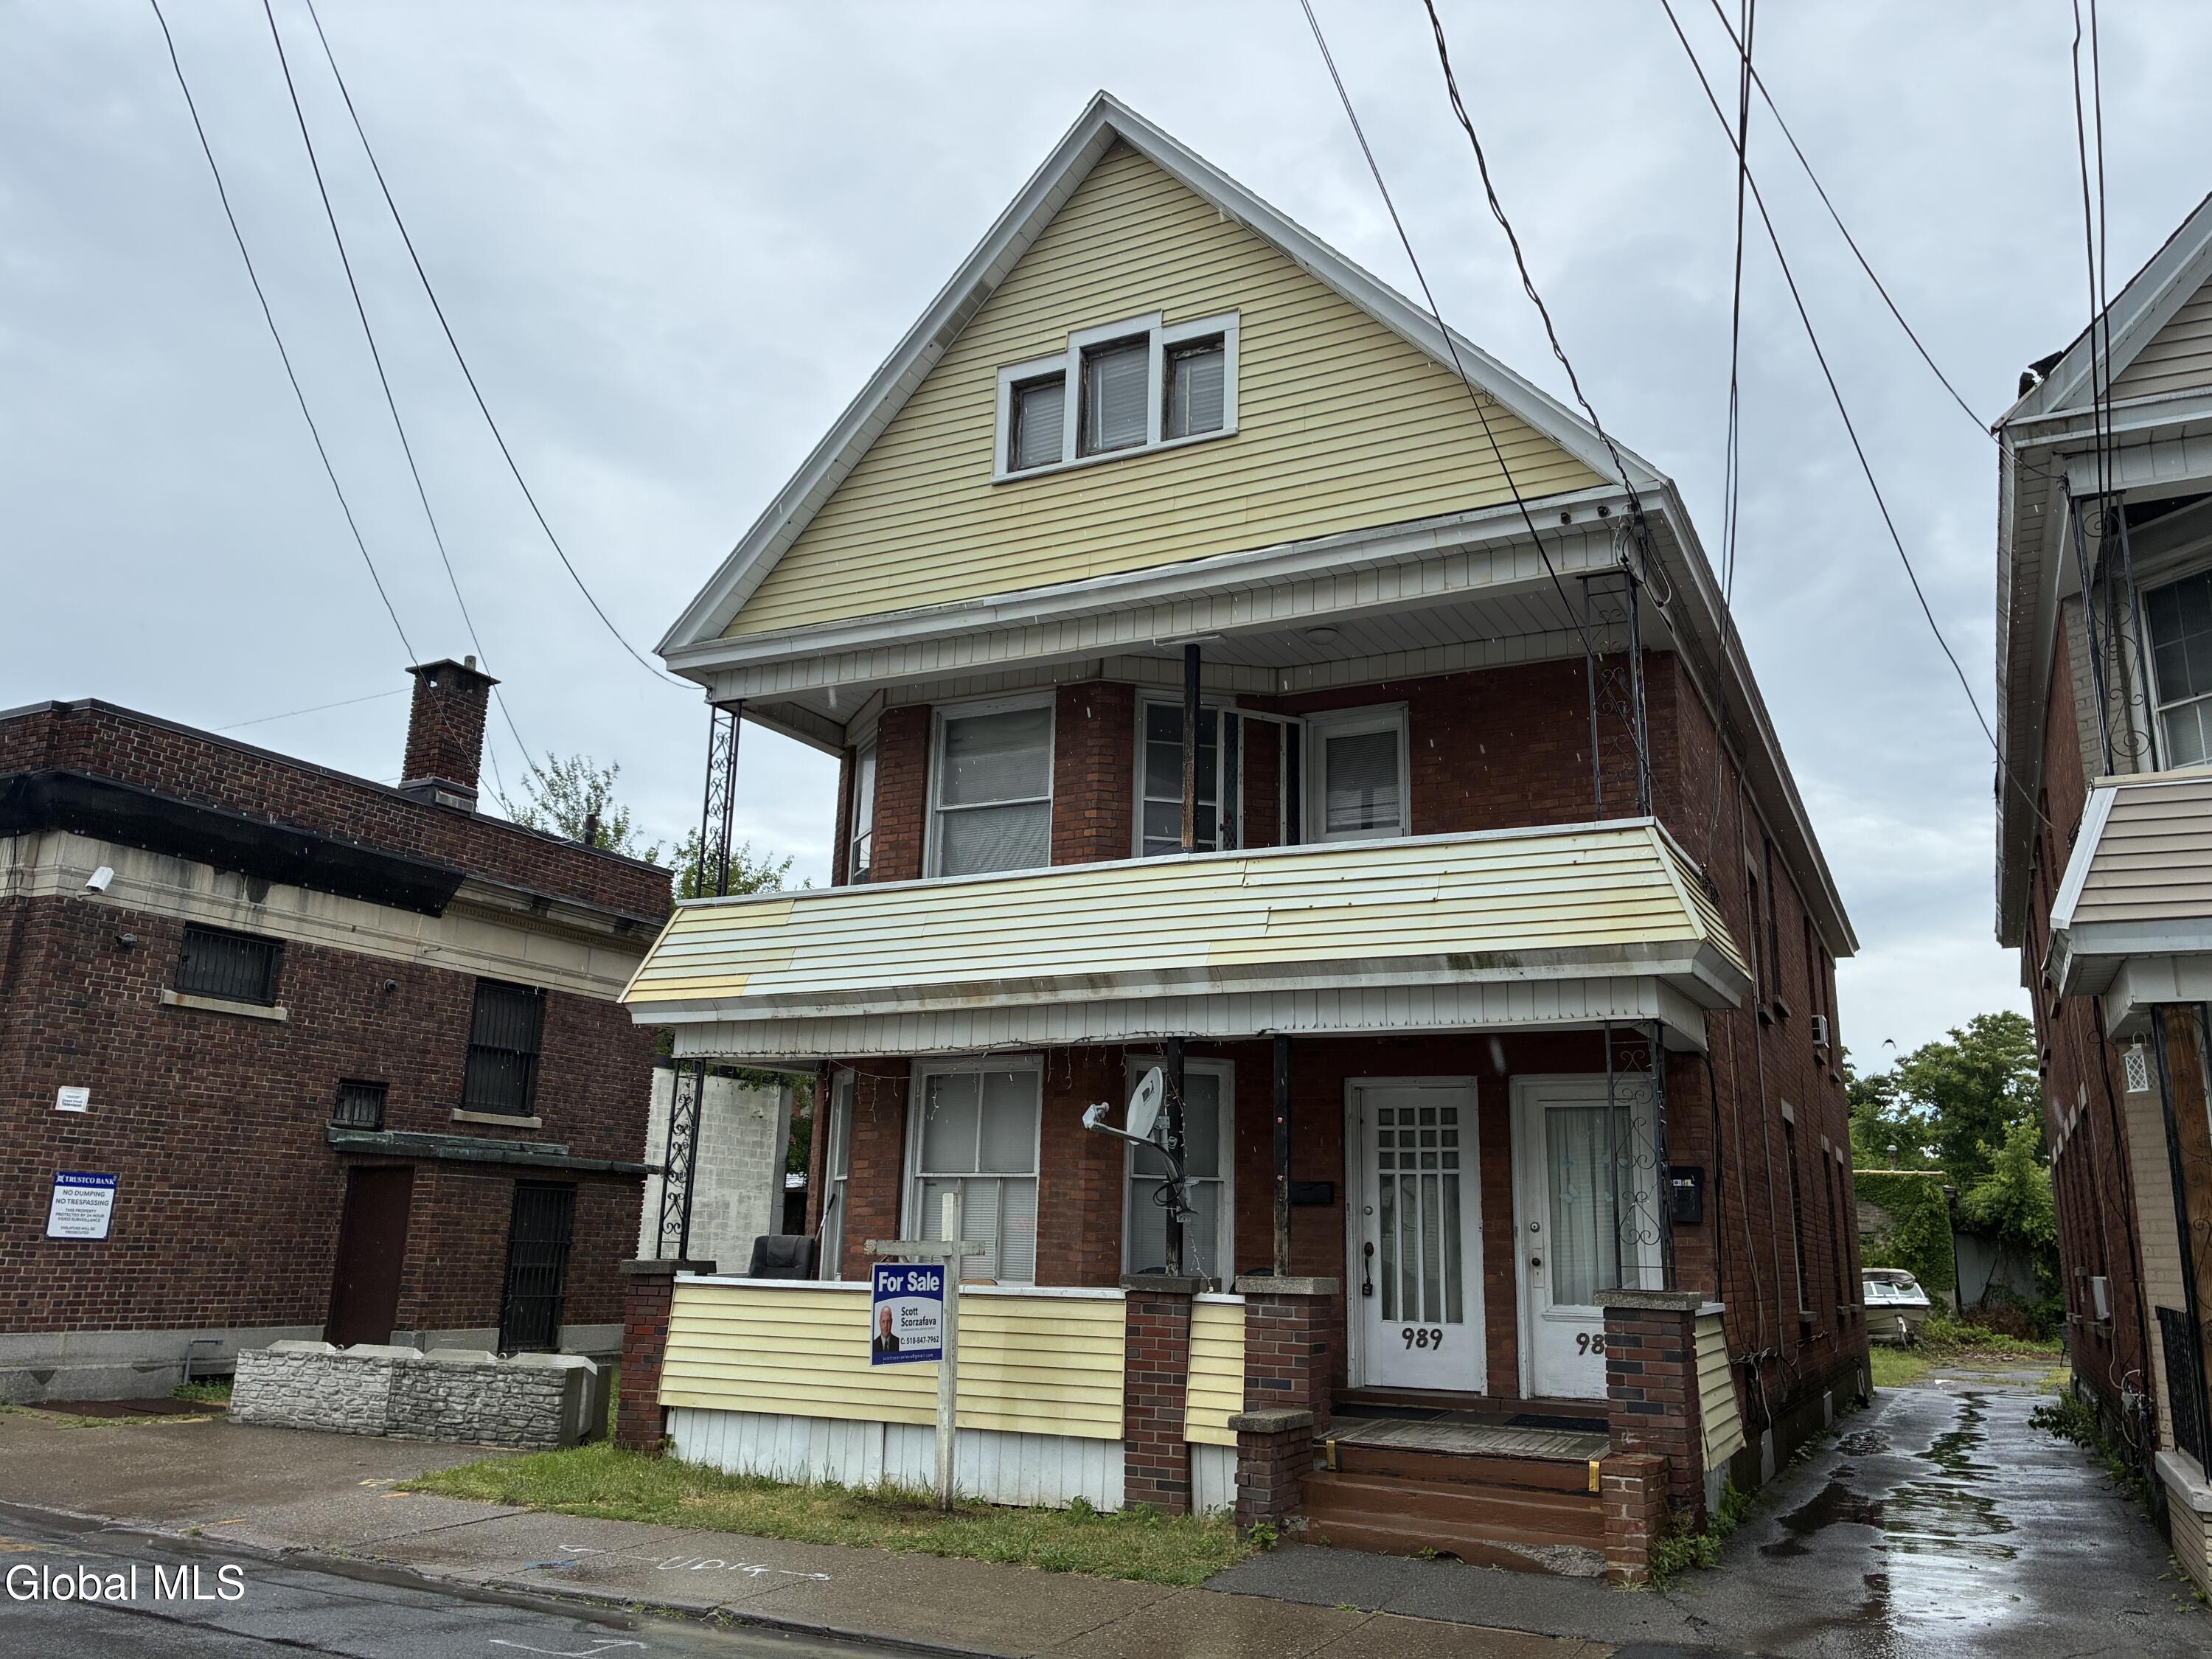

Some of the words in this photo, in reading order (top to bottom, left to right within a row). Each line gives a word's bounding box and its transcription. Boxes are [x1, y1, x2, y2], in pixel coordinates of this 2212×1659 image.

[67, 1198, 109, 1206] TRESPASSING
[878, 1271, 904, 1292] For
[907, 1271, 940, 1292] Sale
[901, 1307, 918, 1316] Scott
[901, 1315, 936, 1327] Scorzafava
[906, 1335, 939, 1345] 518-847-7962
[1402, 1327, 1443, 1351] 989
